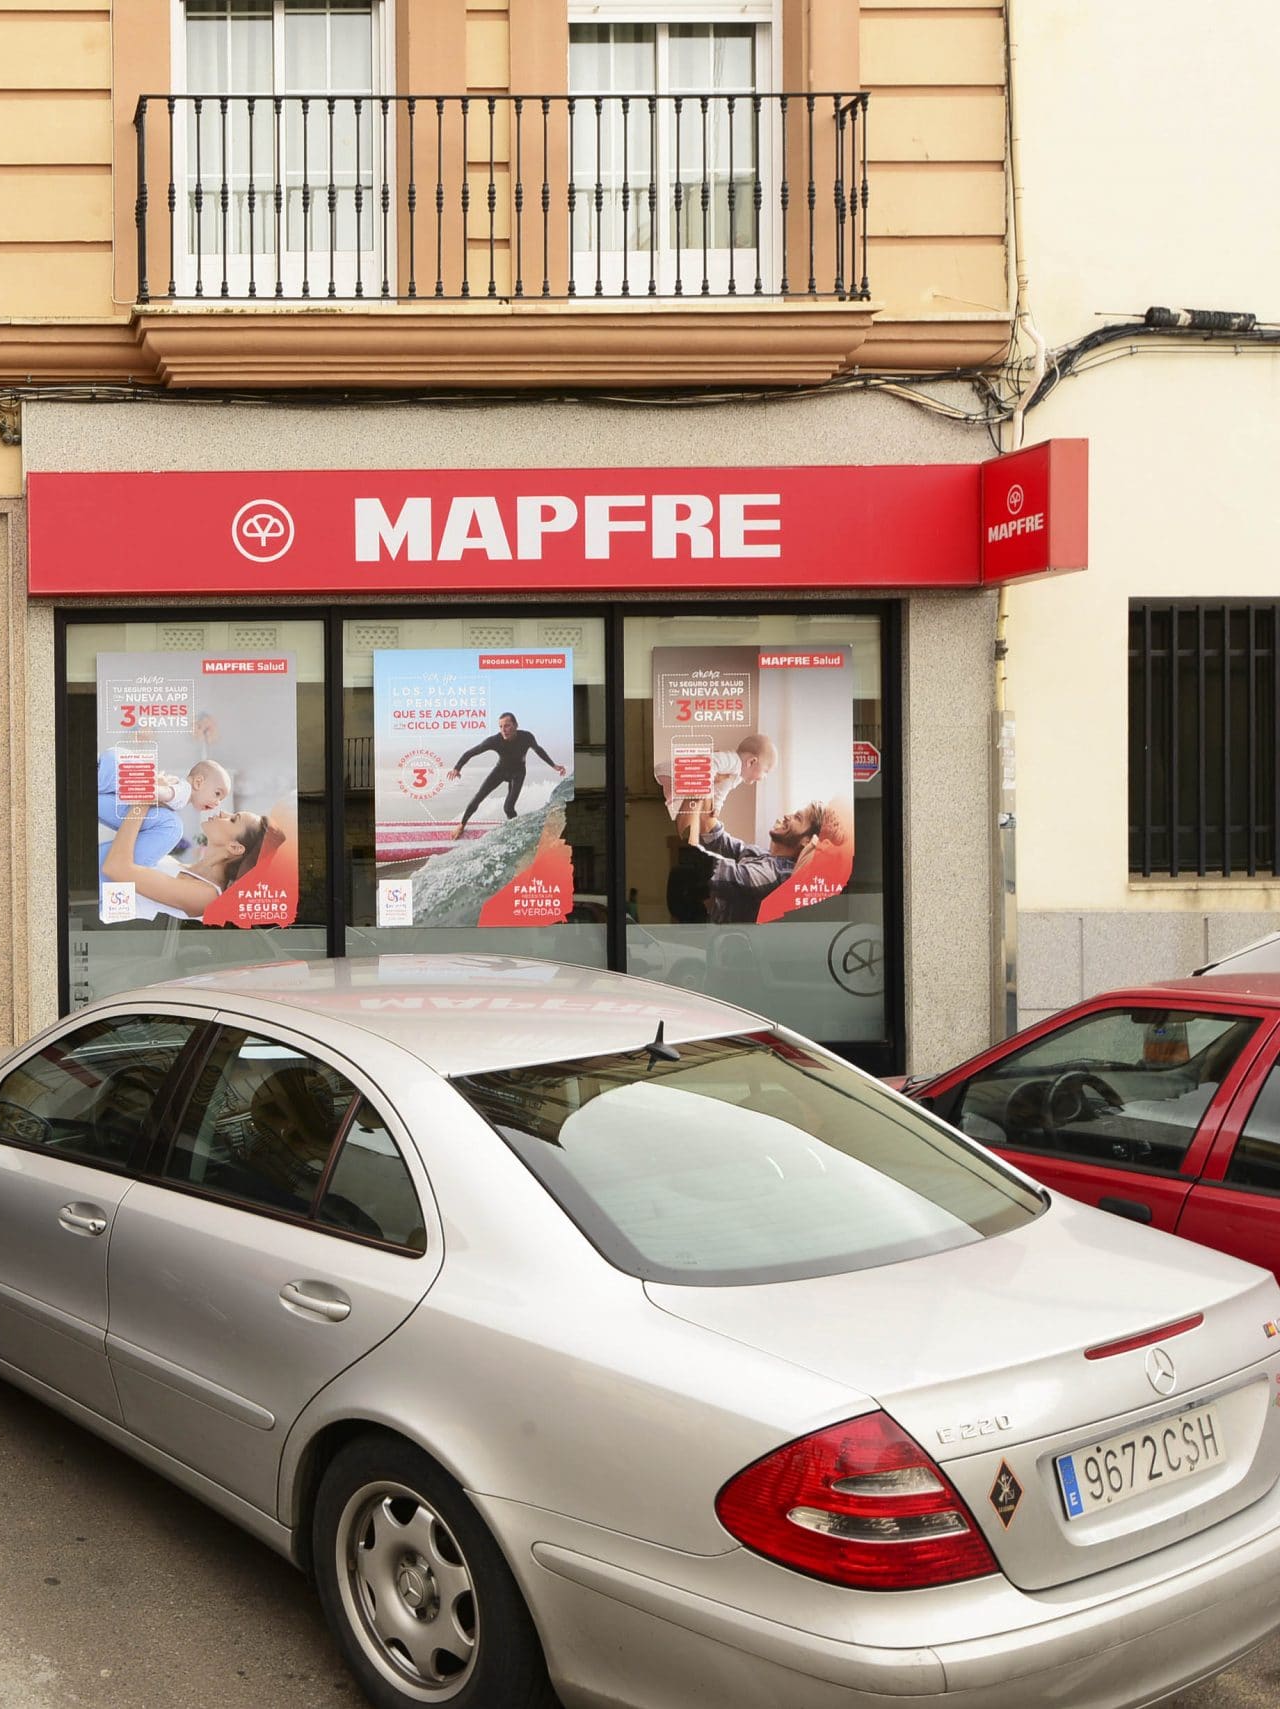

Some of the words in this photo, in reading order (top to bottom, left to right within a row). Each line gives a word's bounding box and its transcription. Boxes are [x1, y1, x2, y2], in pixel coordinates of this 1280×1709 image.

[355, 494, 781, 561] MAPFRE
[988, 512, 1044, 543] MAPFRE
[761, 656, 810, 666] MAPFRE
[813, 656, 841, 665] Salud
[205, 662, 254, 671] MAPFRE
[257, 662, 285, 671] Salud
[393, 687, 421, 697] LOS
[428, 686, 486, 696] PLANES
[682, 688, 720, 697] NUEVA
[722, 688, 744, 696] APP
[125, 693, 163, 702] NUEVA
[167, 693, 188, 701] APP
[406, 698, 486, 708] PENSIONES
[393, 710, 415, 719] QUE
[419, 710, 432, 719] SE
[435, 709, 486, 718] ADAPTAN
[676, 700, 691, 722] 3
[694, 699, 744, 710] MESES
[120, 705, 136, 728] 3
[139, 705, 188, 716] MESES
[694, 711, 744, 721] GRATIS
[138, 716, 188, 727] GRATIS
[407, 721, 439, 730] CICLO
[443, 721, 456, 730] DE
[460, 720, 486, 730] VIDA
[514, 885, 560, 893] FAMILIA
[794, 884, 843, 893] FAMILIA
[238, 890, 287, 899] FAMILIA
[238, 903, 288, 912] SEGURO
[514, 899, 560, 907] FUTURO
[247, 911, 288, 920] VERDAD
[521, 908, 561, 916] VERDAD
[936, 1427, 956, 1444] E
[960, 1415, 1013, 1440] 220
[1070, 1492, 1078, 1506] E
